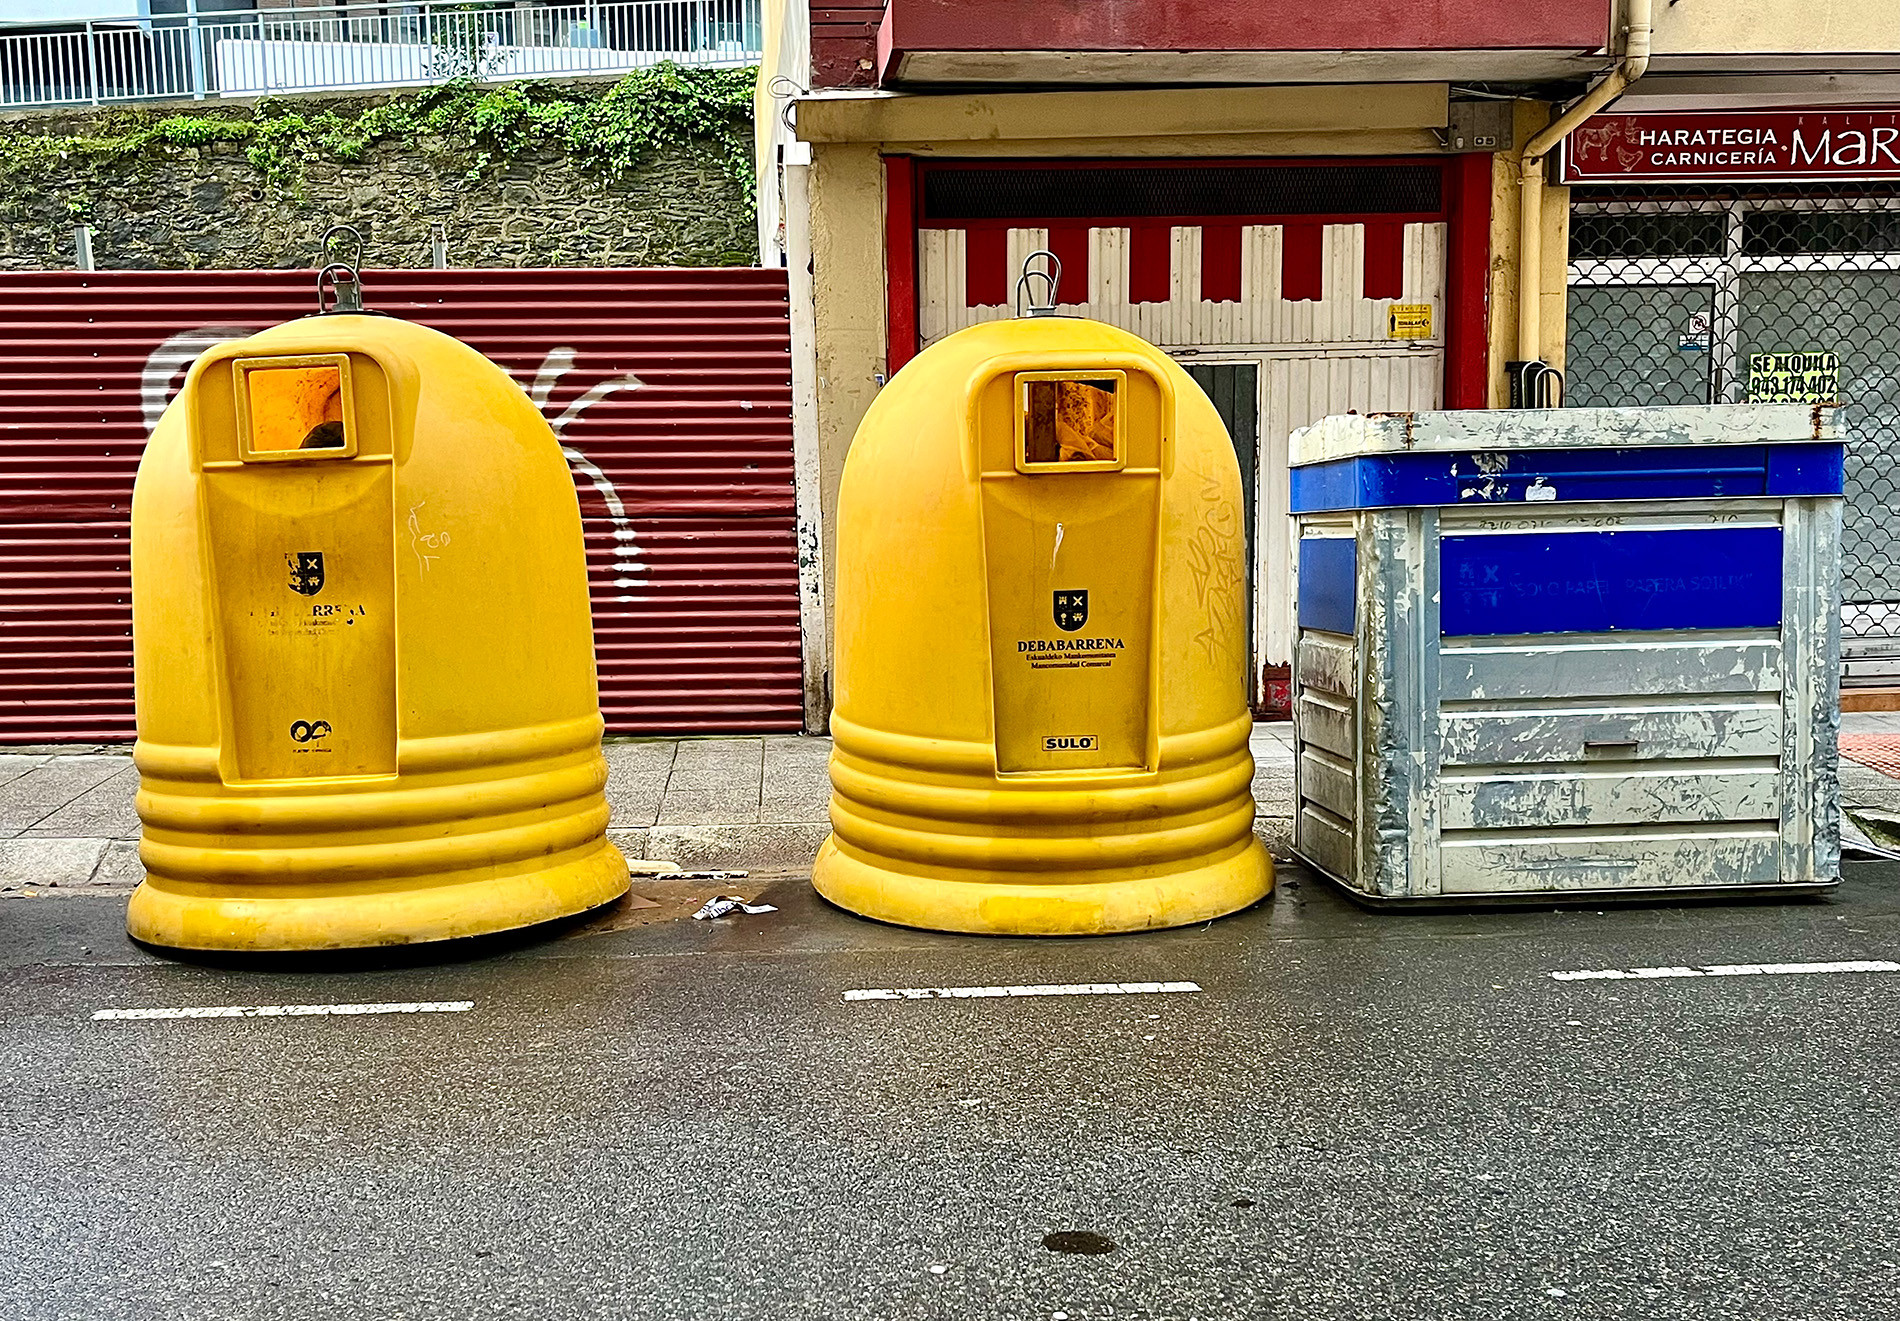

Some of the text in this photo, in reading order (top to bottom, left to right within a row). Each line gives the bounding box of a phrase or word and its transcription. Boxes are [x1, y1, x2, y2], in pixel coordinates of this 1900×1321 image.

[1640, 128, 1778, 147] HARATEGIA
[1651, 149, 1777, 166] CARNICERÍA
[1753, 355, 1836, 374] SE ALQUILA
[1017, 638, 1125, 653] DEBABARRENA
[1081, 660, 1112, 668] Comarcal
[1046, 737, 1092, 749] SULO
